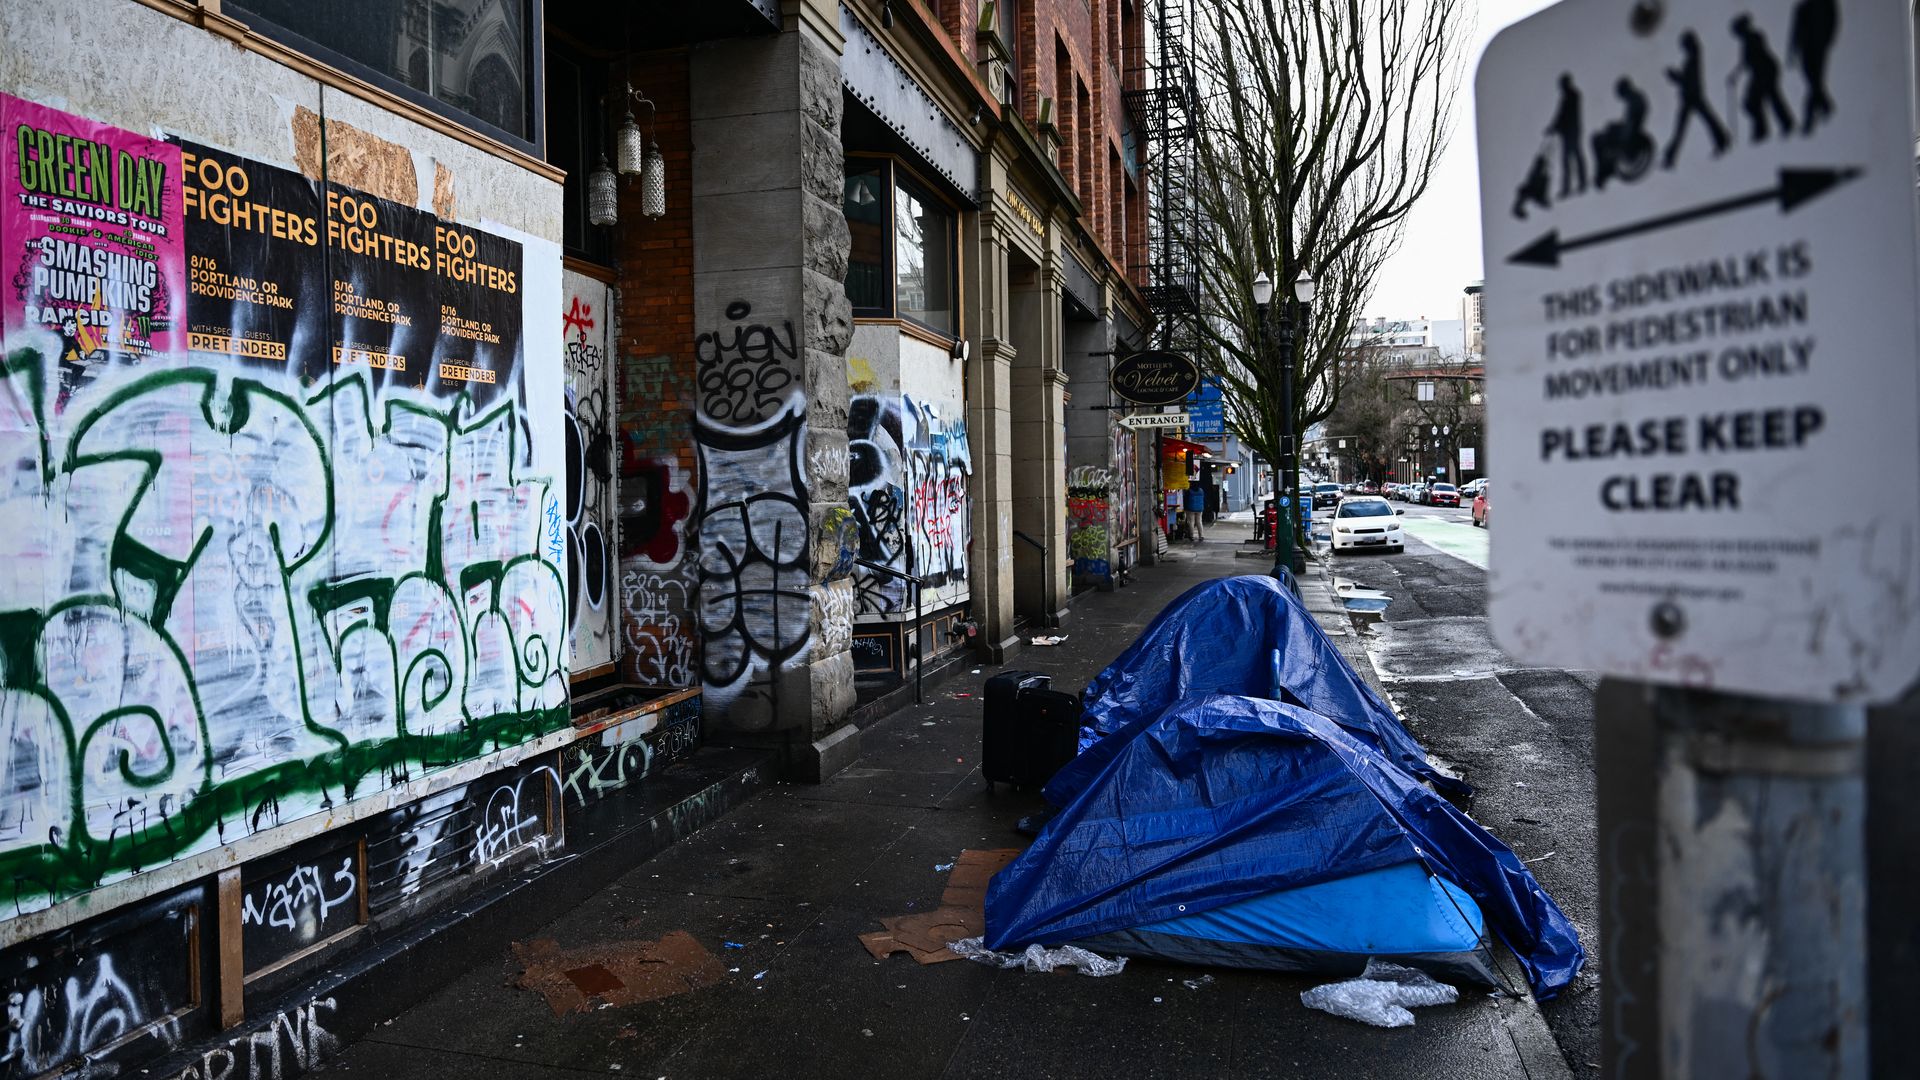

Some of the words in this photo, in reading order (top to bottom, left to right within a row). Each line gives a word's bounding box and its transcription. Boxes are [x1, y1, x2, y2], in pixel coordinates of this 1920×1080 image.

[17, 124, 112, 206] GREEN
[118, 150, 166, 219] DAY
[181, 151, 249, 197] FOO
[18, 193, 48, 208] THE
[52, 199, 128, 225] SAVIORS
[131, 217, 167, 236] TOUR
[182, 185, 318, 246] FIGHTERS
[327, 190, 378, 229] FOO
[49, 224, 87, 236] DOOKIE
[107, 233, 155, 251] AMERICAN
[435, 225, 476, 259] FOO
[26, 241, 42, 250] THE
[135, 249, 159, 261] IDIOT
[327, 219, 431, 271] FIGHTERS
[40, 236, 157, 289] SMASHING
[190, 254, 217, 271] 8/16
[436, 251, 516, 294] FIGHTERS
[34, 265, 151, 313] PUMPKINS
[190, 268, 259, 293] PORTLAND,
[261, 281, 278, 295] OR
[334, 280, 354, 294] 8/16
[1542, 282, 1603, 323] THIS
[1607, 249, 1770, 311] SIDEWALK
[1778, 239, 1813, 282] IS
[191, 281, 265, 305] PROVIDENCE
[266, 294, 294, 310] PARK
[334, 292, 386, 312] PORTLAND,
[387, 302, 400, 314] OR
[25, 305, 113, 326] RANCID
[334, 303, 390, 323] PROVIDENCE
[390, 313, 412, 327] PARK
[441, 304, 457, 316] 8/16
[192, 324, 211, 334] WITH
[441, 315, 480, 332] PORTLAND,
[481, 322, 492, 333] OR
[441, 325, 483, 341] PROVIDENCE
[484, 333, 500, 344] PARK
[1546, 328, 1602, 363] FOR
[1606, 290, 1809, 353] PEDESTRIAN
[124, 338, 151, 348] LINDA
[192, 335, 284, 358] PRETENDERS
[442, 365, 495, 383] PRETENDERS
[1123, 368, 1179, 391] Velvet
[1543, 353, 1713, 402] MOVEMENT
[1717, 336, 1818, 383] ONLY
[1128, 415, 1185, 426] ENTRANCE
[1540, 415, 1689, 463] PLEASE
[1698, 404, 1826, 454] KEEP
[1600, 471, 1741, 513] CLEAR
